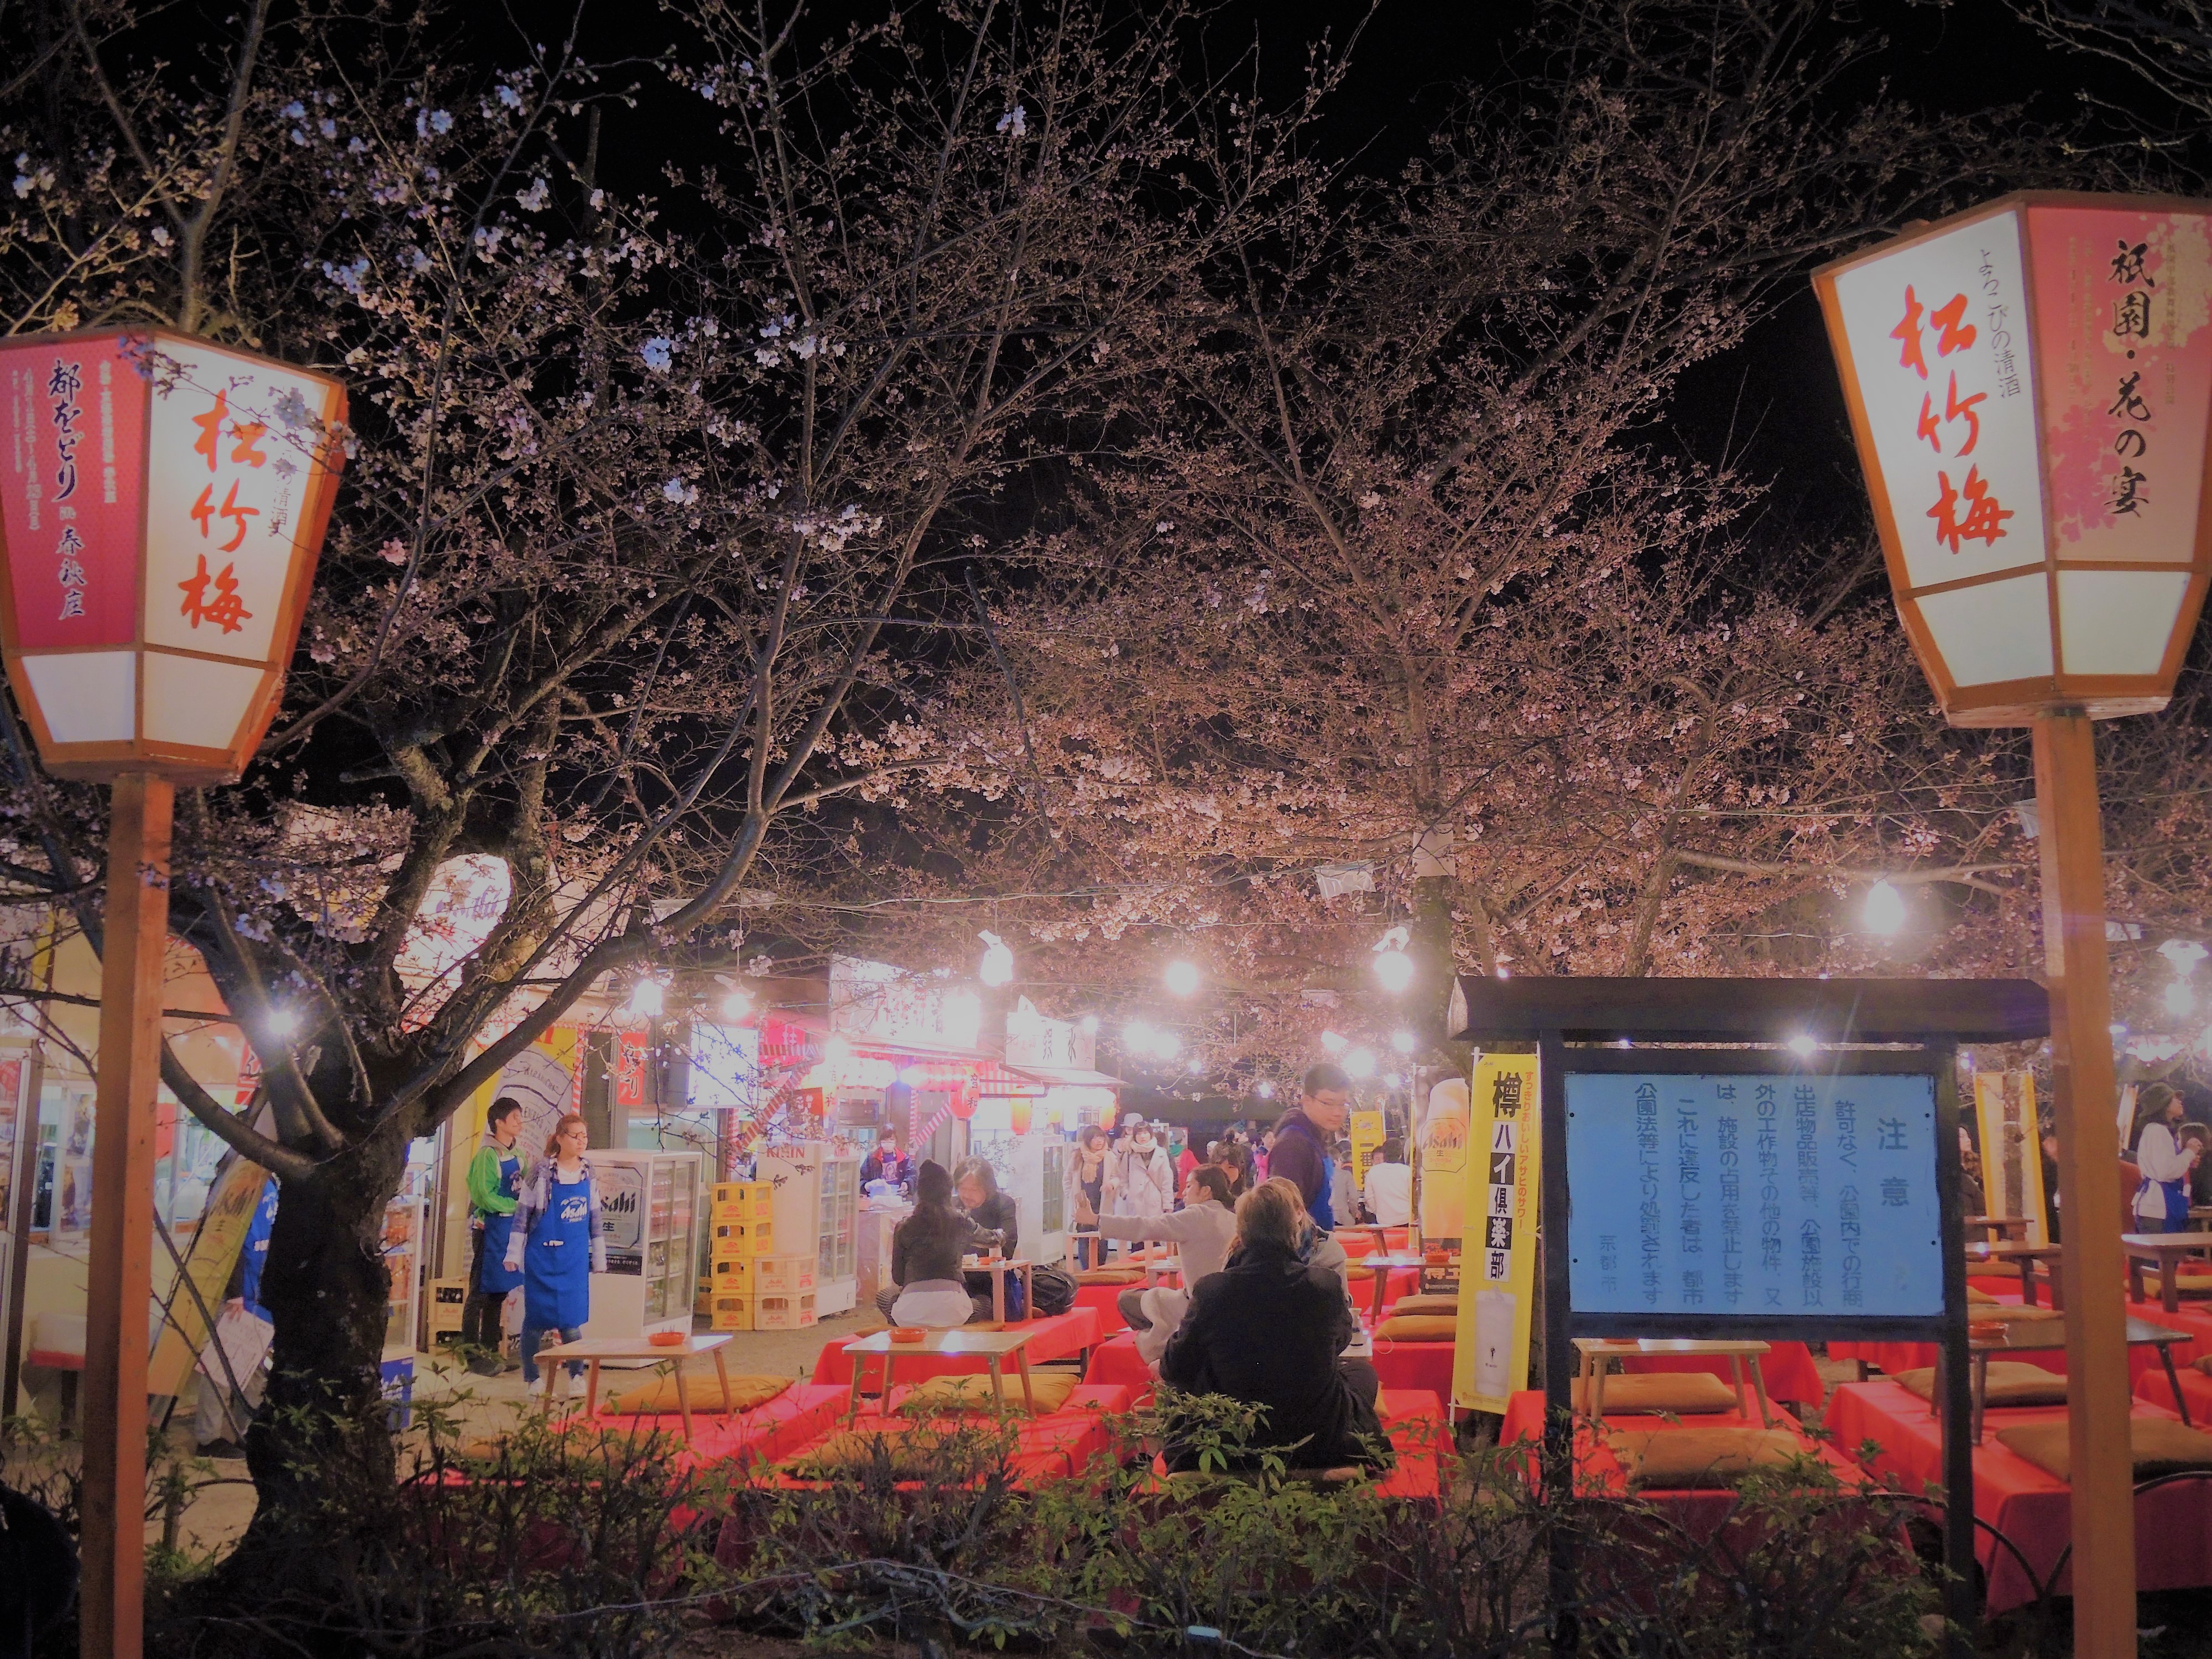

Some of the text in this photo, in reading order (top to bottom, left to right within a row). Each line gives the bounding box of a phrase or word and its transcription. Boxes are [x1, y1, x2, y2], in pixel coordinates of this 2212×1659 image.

[1979, 249, 2021, 398] よろこびの清酒
[2104, 240, 2156, 519] 祇園・花の宴
[48, 359, 84, 501] 都をどり
[1888, 283, 2015, 555] 松竹梅
[56, 525, 87, 620] 春秋座
[178, 389, 268, 634] 松竹梅
[560, 1201, 587, 1219] Asahi
[601, 1191, 636, 1214] sahi
[1423, 1132, 1463, 1150] Asahi
[1489, 1071, 1523, 1280] 樽ハイ倶楽部
[1517, 1071, 1534, 1229] すっきりおいしいアサヒのサワー
[1877, 1117, 1910, 1207] 注意
[603, 1222, 615, 1232] 生
